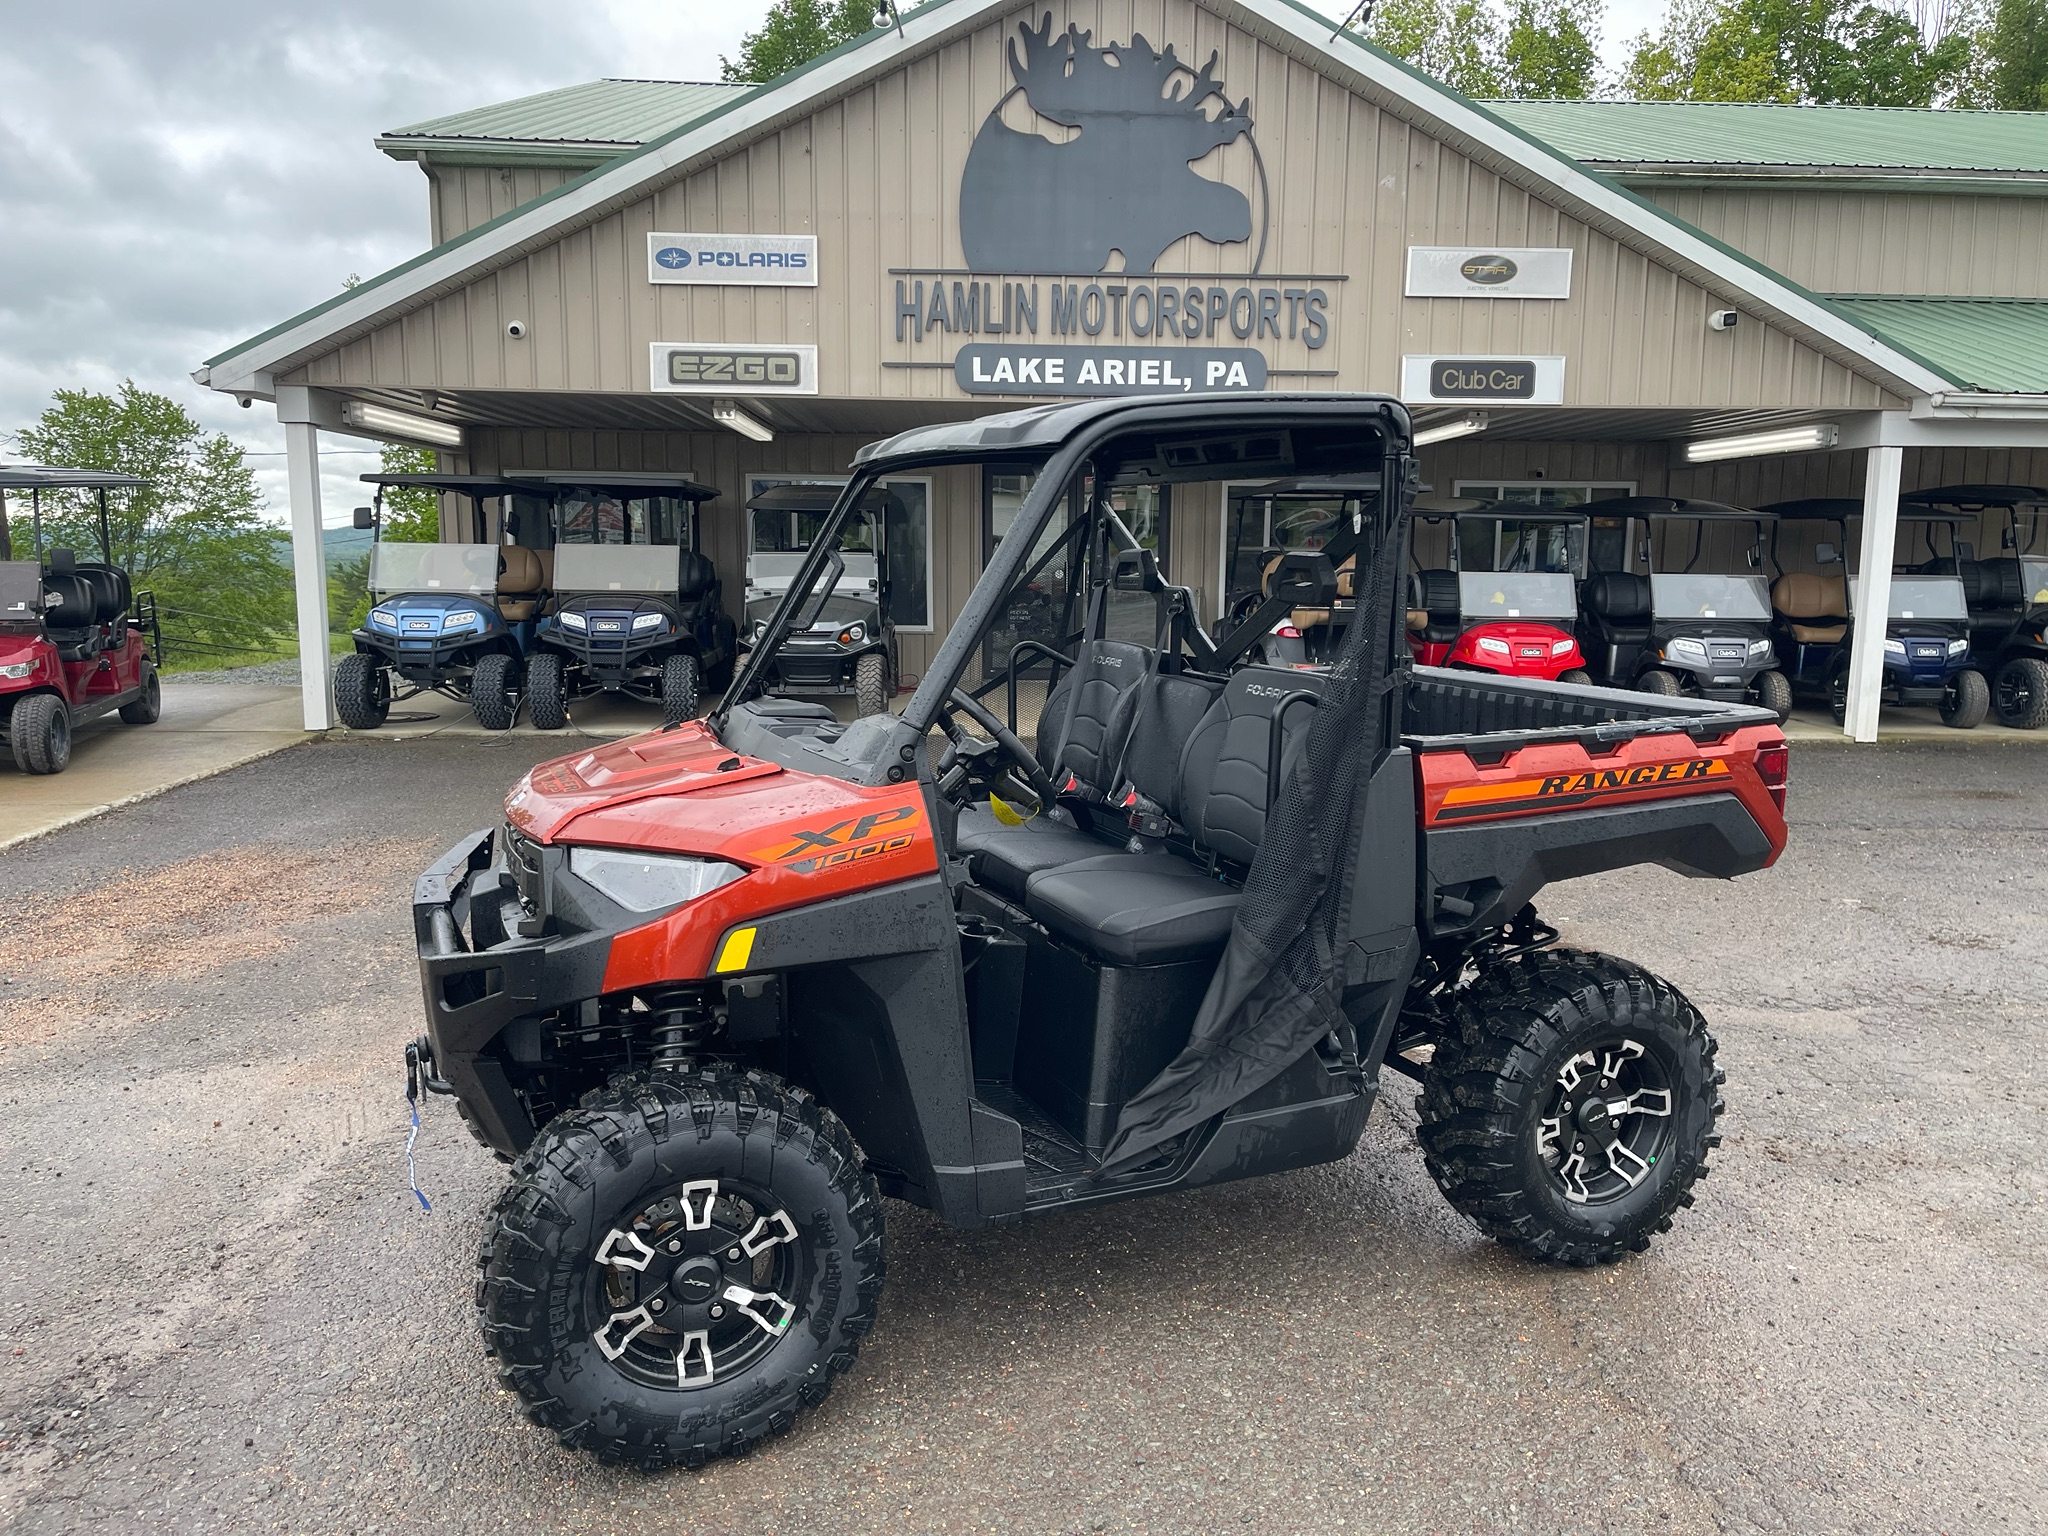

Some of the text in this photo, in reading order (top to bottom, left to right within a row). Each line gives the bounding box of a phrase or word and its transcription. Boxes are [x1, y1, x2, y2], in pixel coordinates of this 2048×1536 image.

[698, 252, 807, 268] POLARIS
[1463, 265, 1507, 275] STAR
[896, 280, 1329, 349] HAMLIN MOTORSPORTS
[972, 356, 1249, 391] LAKE ARIEL, PA
[1441, 369, 1525, 390] Club Car
[1091, 655, 1123, 668] POLARIS
[1537, 759, 1714, 796] RANGER
[775, 805, 918, 861] XP
[814, 835, 913, 870] 1000
[683, 1278, 711, 1288] XP
